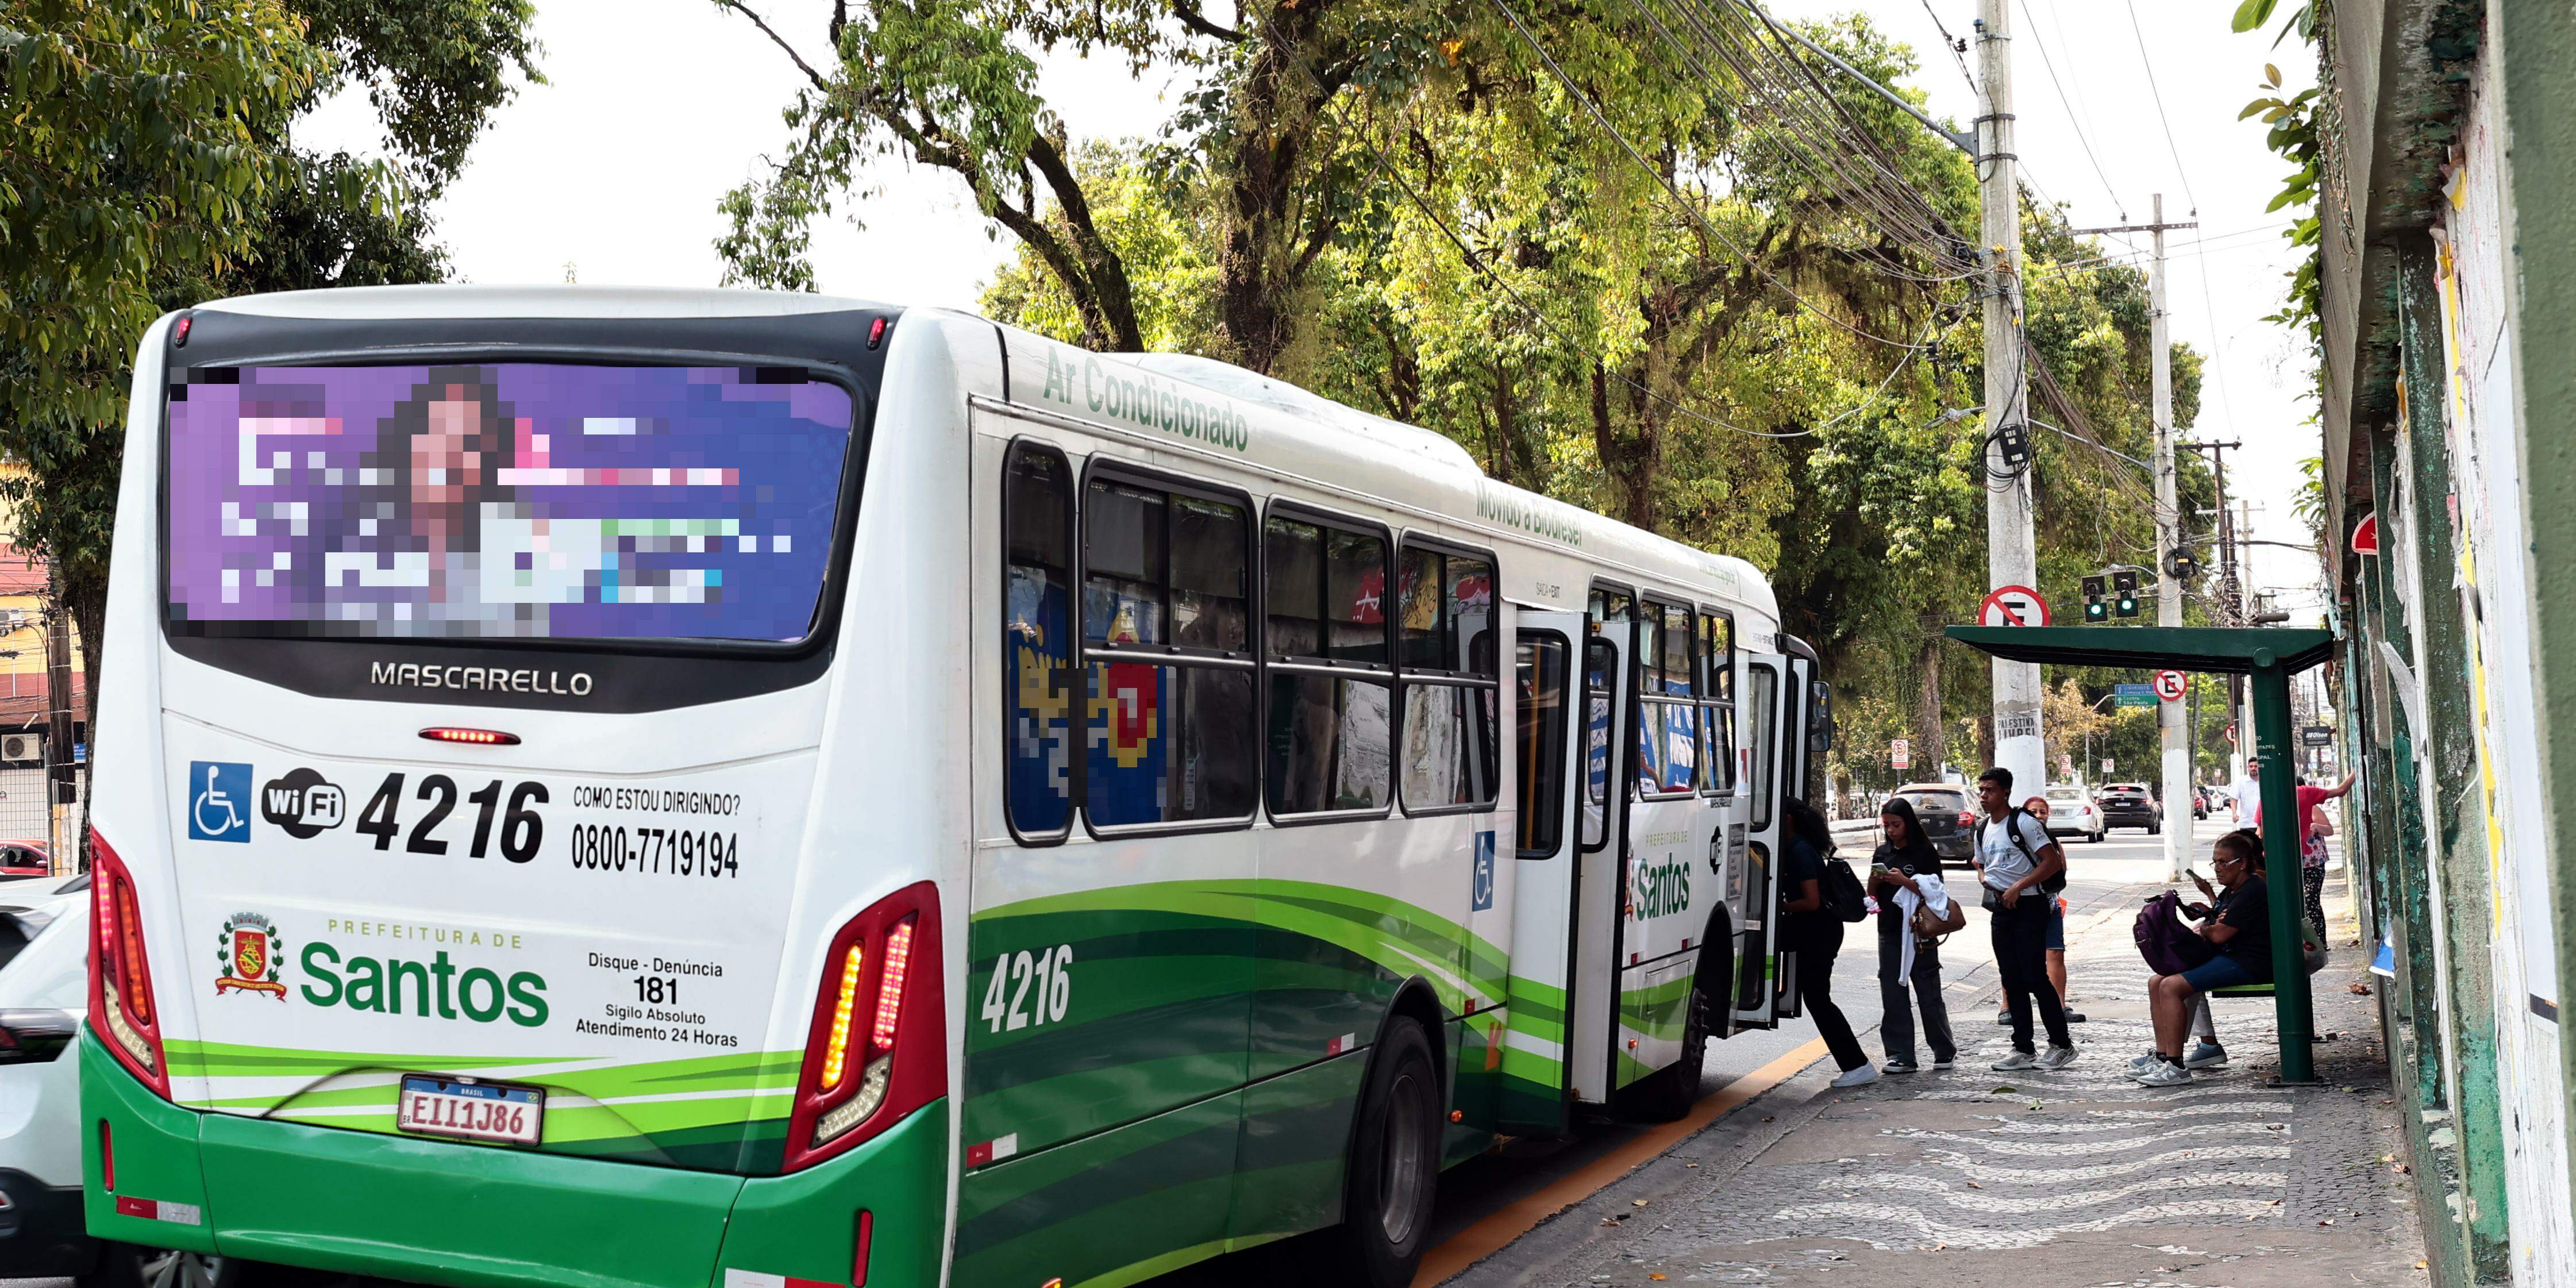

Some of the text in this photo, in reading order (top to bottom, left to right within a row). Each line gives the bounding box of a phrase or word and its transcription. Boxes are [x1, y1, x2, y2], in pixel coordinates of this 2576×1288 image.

[1042, 344, 1248, 452] Ar Condicionado
[1476, 480, 1582, 547] Movido a Biodiesel
[1551, 585, 1560, 598] EXIT
[370, 662, 593, 696] MASCARELLO
[1998, 718, 2034, 729] PALESTINA
[268, 787, 337, 820] WiFi
[573, 786, 741, 816] COMO ESTOU DIRIGINDO?
[356, 772, 550, 863] 4216
[572, 824, 739, 879] 0800-7719194
[1646, 831, 1688, 847] PREFEITURA DE
[1637, 852, 1689, 921] Santos
[329, 919, 522, 949] PREFEITURA DE
[588, 952, 638, 974] Disque
[653, 955, 723, 977] Denúncia
[300, 941, 549, 1027] Santos
[633, 976, 678, 1005] 181
[982, 944, 1073, 1033] 4216
[605, 1004, 706, 1025] Sigilo Absoluto
[576, 1019, 738, 1048] Atendimento 24 Horas
[461, 1088, 484, 1097] BRASIL
[412, 1095, 523, 1135] EII1J86
